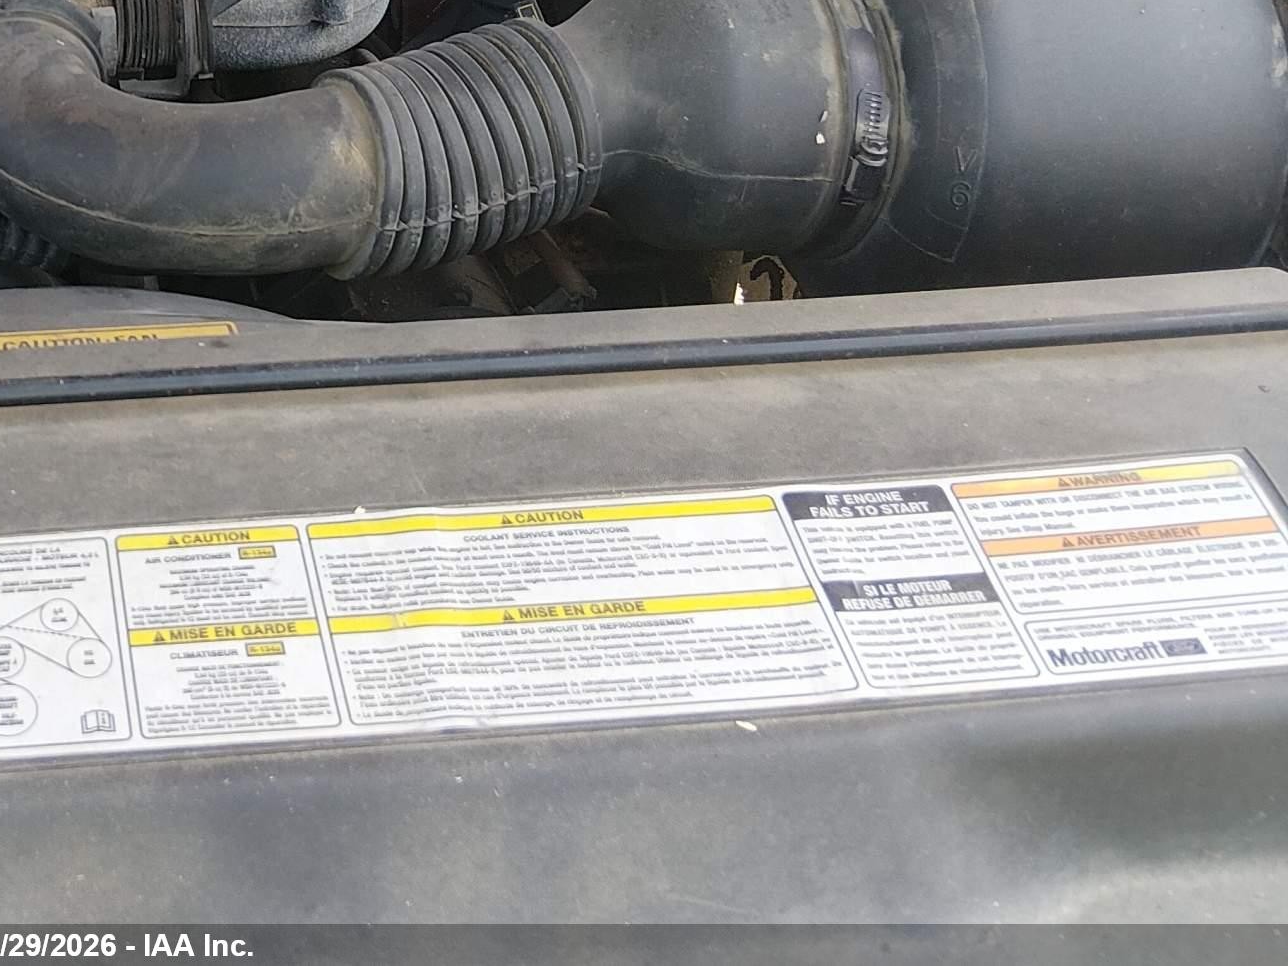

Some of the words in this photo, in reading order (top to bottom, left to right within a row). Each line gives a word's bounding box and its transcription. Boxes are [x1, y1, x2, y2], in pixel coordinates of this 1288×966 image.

[1069, 471, 1142, 487] WARNING
[825, 493, 842, 505] IF
[843, 491, 903, 505] ENGINE
[515, 510, 584, 524] CAUTION
[809, 506, 854, 518] FAILS
[856, 504, 879, 516] TO
[880, 501, 929, 515] START
[182, 531, 251, 545] CAUTION
[463, 533, 509, 542] COOLANT
[513, 531, 555, 540] SERVICE
[558, 525, 629, 537] INSTRUCTIONS
[1077, 526, 1202, 546] AVERTISSEMENT
[145, 556, 161, 564] AIR
[164, 552, 232, 563] CONDITIONER
[864, 585, 879, 597] SI
[880, 583, 897, 595] LE
[898, 580, 952, 593] MOTEUR
[842, 596, 893, 610] REFUSE
[895, 595, 912, 607] DE
[916, 590, 987, 607] DÉMARRER
[519, 607, 560, 619] MISE
[565, 605, 584, 617] EN
[590, 602, 646, 615] GARDE
[169, 629, 209, 643] MISE
[215, 626, 236, 639] EN
[241, 622, 297, 637] GARDE
[461, 629, 517, 639] ENTRETIEN
[521, 626, 535, 635] DU
[539, 624, 578, 634] CIRCUIT
[582, 623, 596, 632] DE
[170, 649, 238, 660] CLIMATISEUR
[1046, 640, 1164, 668] Motorcraft
